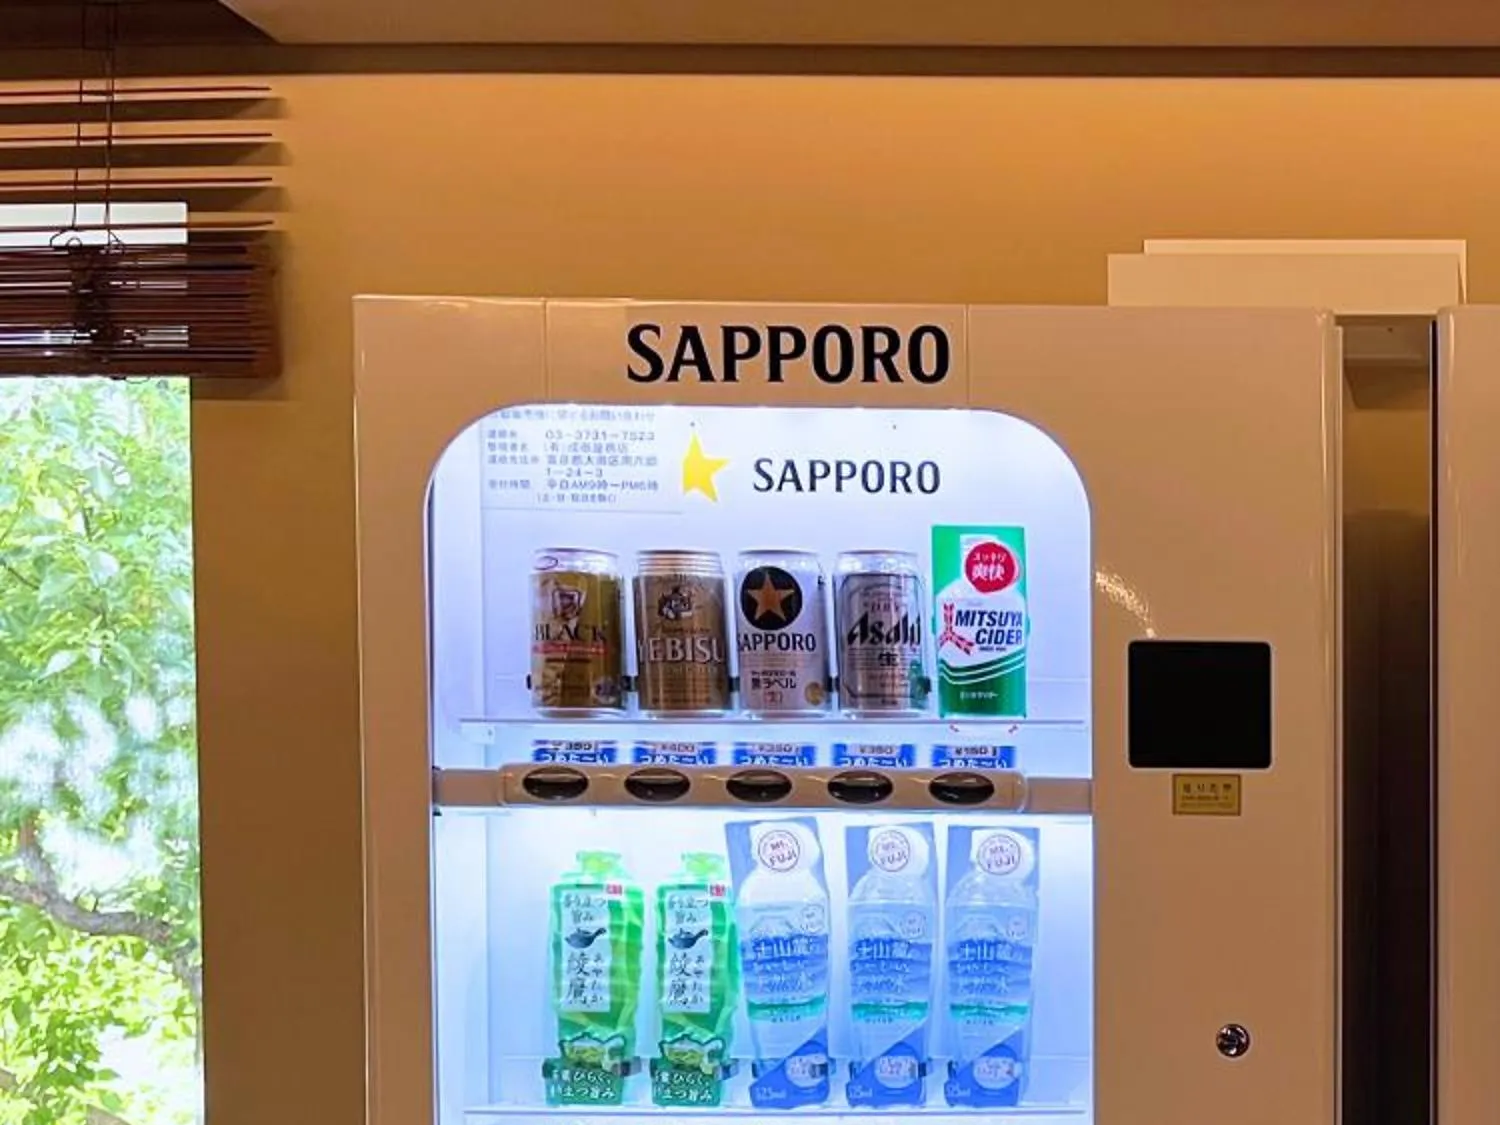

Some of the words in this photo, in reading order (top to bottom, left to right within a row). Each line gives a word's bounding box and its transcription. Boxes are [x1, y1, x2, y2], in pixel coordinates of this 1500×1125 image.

[627, 323, 950, 384] SAPPORO
[752, 458, 941, 495] SAPPORO
[535, 623, 607, 641] BLACK
[847, 611, 921, 650] Asahi
[955, 609, 1023, 628] MITSUYA
[975, 629, 1023, 645] CIDER
